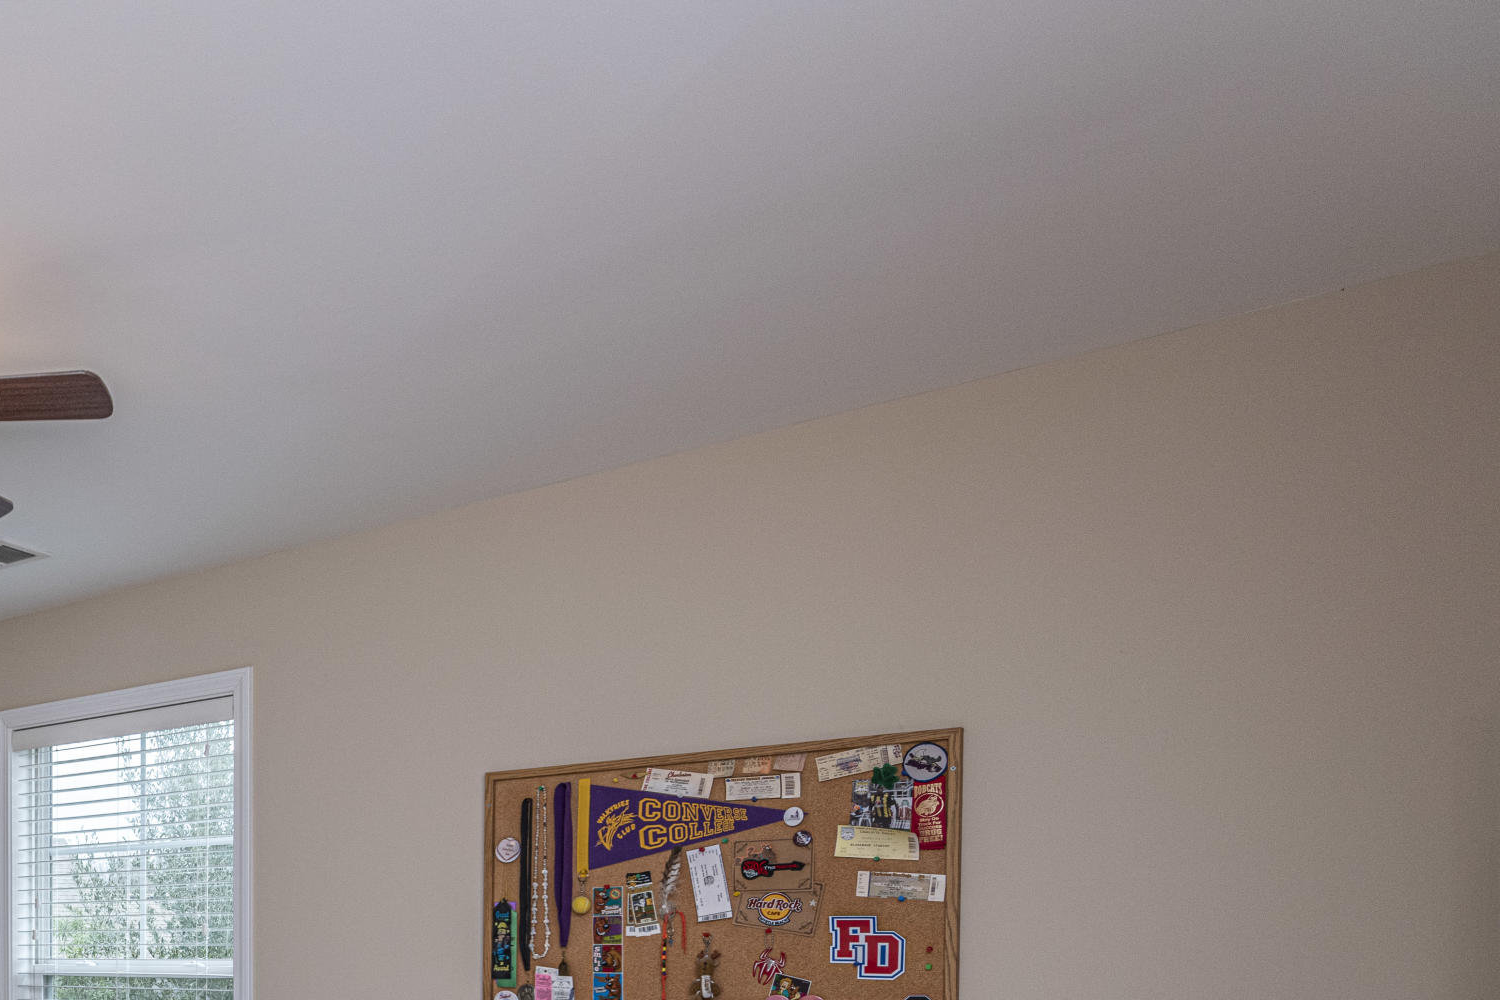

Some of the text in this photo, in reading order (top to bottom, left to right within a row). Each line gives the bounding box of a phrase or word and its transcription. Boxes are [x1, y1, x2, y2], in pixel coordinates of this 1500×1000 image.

[914, 782, 943, 798] BOBCATS
[597, 799, 630, 824] VALKYRIES
[638, 798, 748, 822] CONVERSE
[617, 824, 636, 839] CLUB
[639, 820, 735, 850] COLLEGE
[748, 898, 803, 911] Hard Rock
